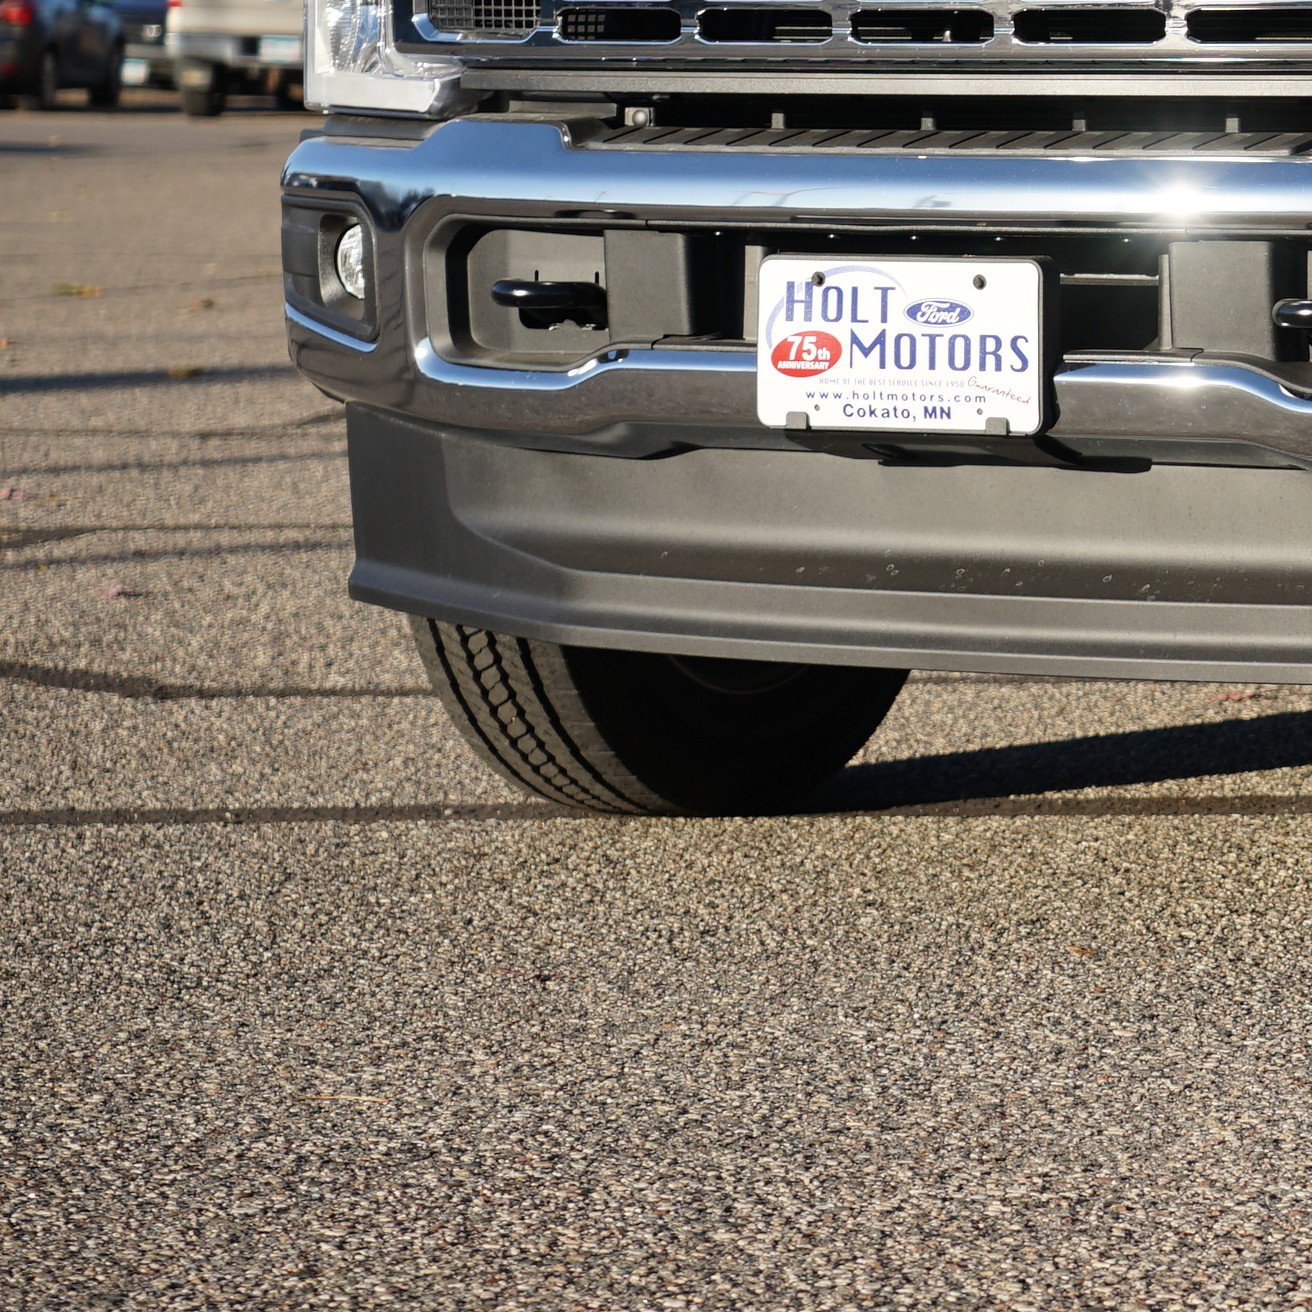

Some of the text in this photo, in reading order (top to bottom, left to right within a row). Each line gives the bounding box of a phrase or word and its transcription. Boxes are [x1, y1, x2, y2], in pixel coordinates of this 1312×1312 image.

[785, 281, 896, 324] HOLT
[916, 301, 961, 324] Ford
[786, 335, 831, 361] 75th
[850, 328, 1029, 372] MOTORS
[777, 360, 830, 371] ANNIVERSARY
[806, 390, 986, 403] www.holtmotors.com
[967, 376, 1031, 406] Guaranteed
[843, 403, 952, 422] Cokato, MN
